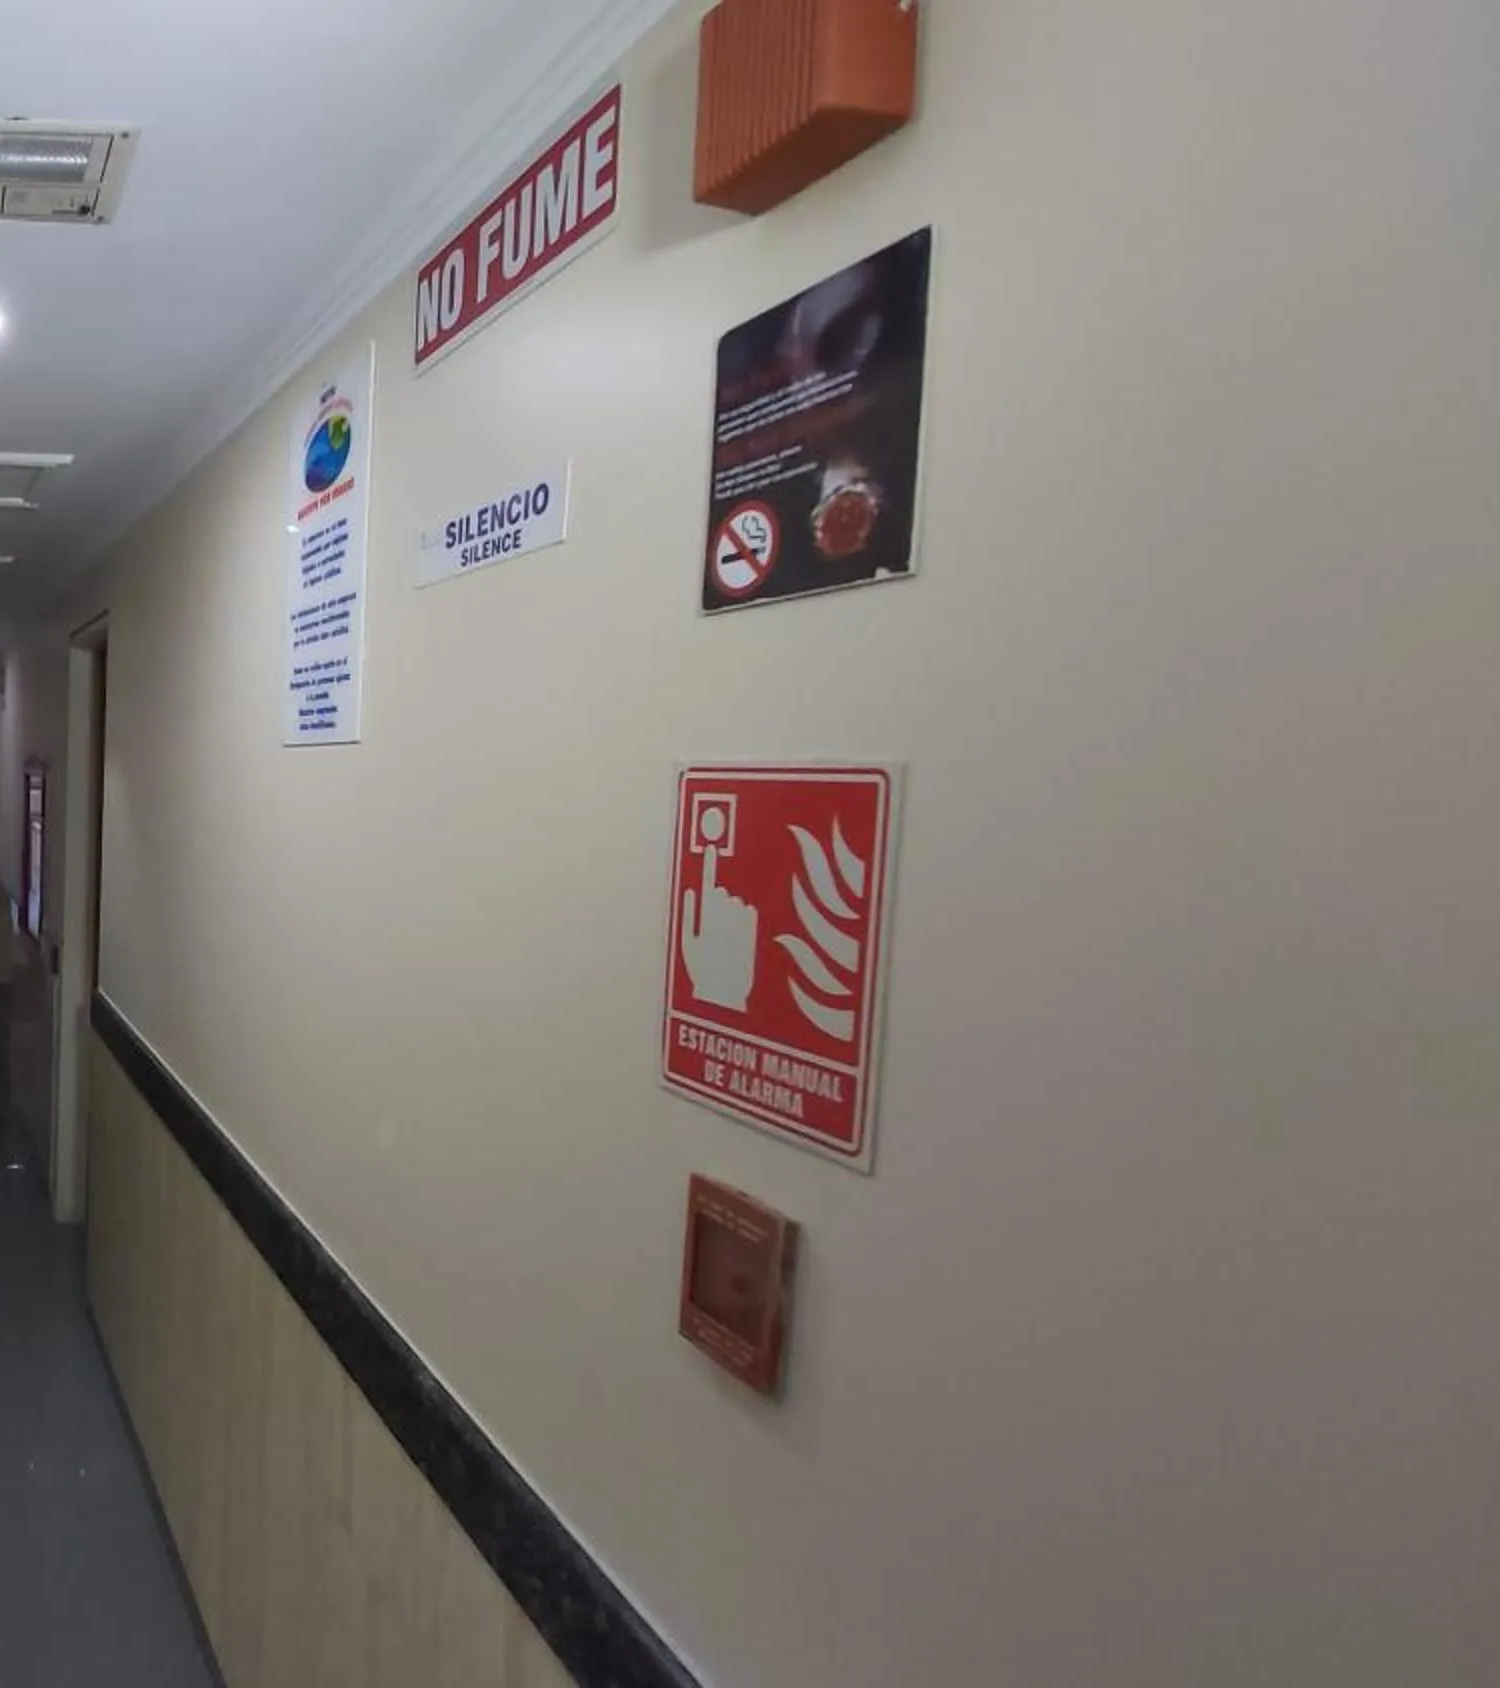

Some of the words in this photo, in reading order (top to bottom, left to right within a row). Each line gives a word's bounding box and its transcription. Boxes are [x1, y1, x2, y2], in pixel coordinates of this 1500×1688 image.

[417, 247, 465, 352] NO
[477, 104, 616, 303] FUME
[445, 482, 549, 549] SILENCIO
[460, 528, 522, 567] SILENCE
[678, 1023, 758, 1071] ESTACION
[761, 1050, 843, 1103] MANUAL
[704, 1060, 725, 1087] DE
[729, 1069, 804, 1119] ALARMA
